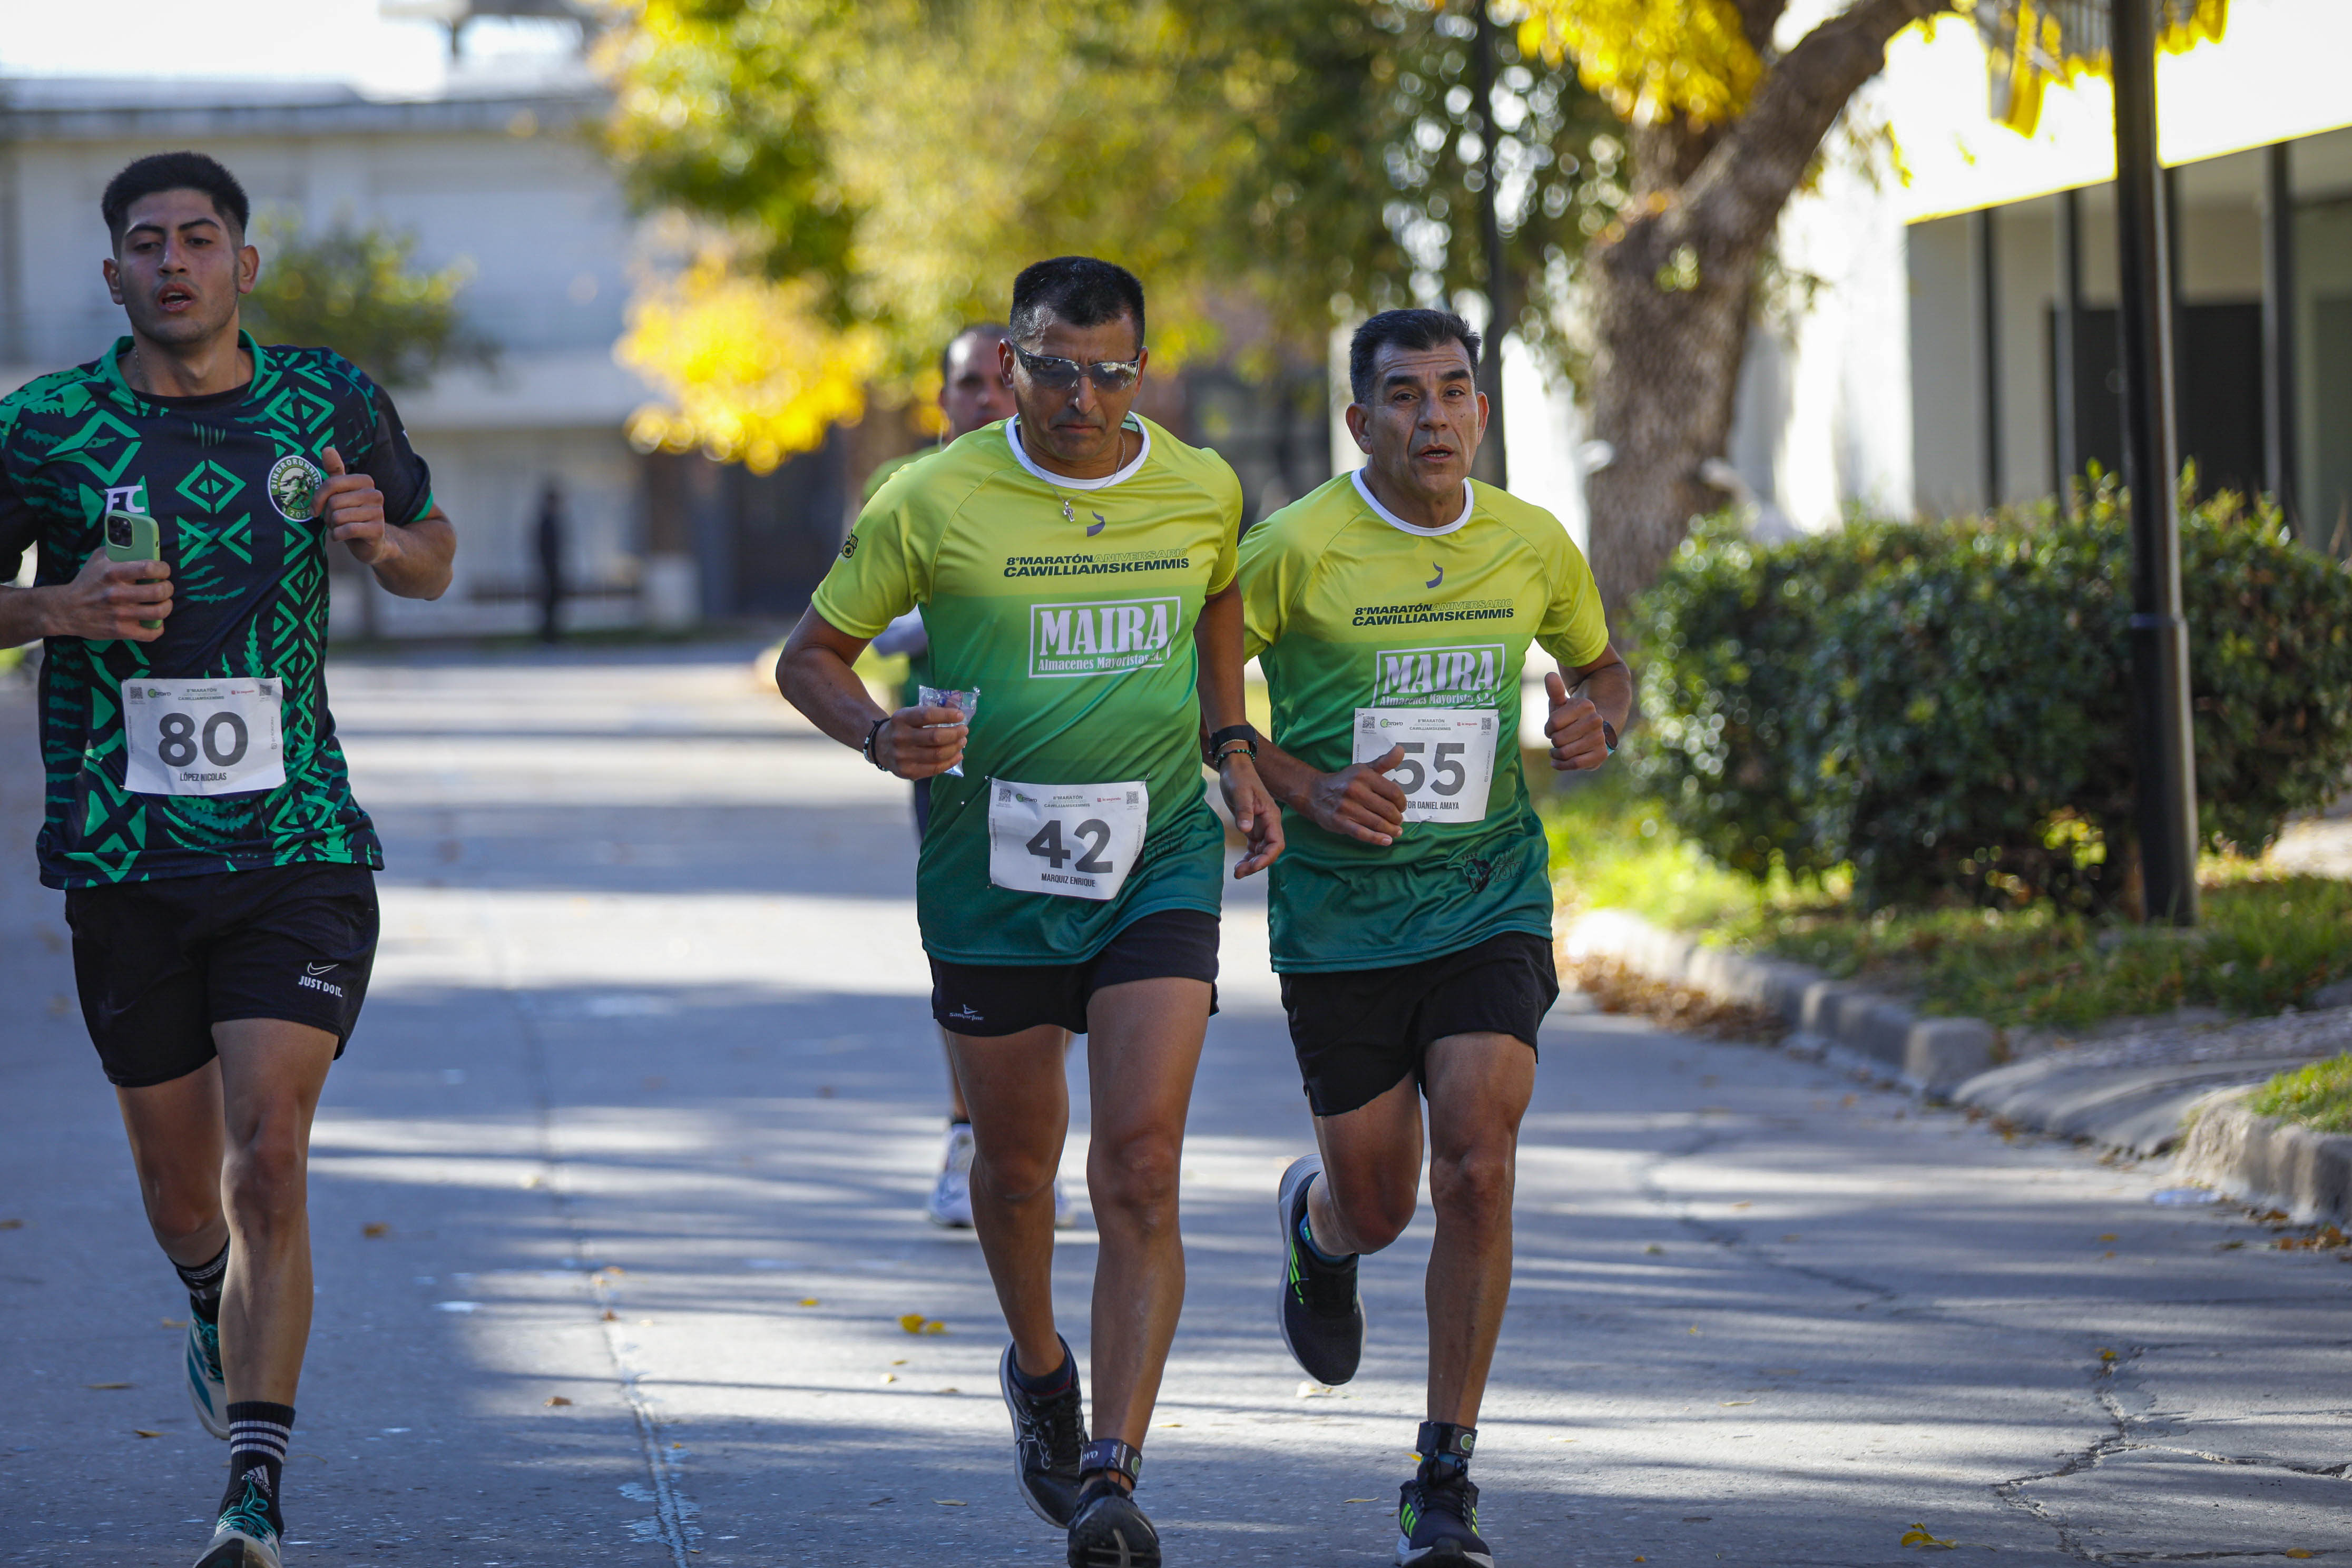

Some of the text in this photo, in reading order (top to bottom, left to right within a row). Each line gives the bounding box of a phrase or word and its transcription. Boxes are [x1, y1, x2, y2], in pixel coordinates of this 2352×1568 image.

[1003, 557, 1190, 577] CAWILLIAMSKEMMIS
[1352, 608, 1514, 626] CAWILLIAMSKEMMIS
[1040, 604, 1168, 656] MAIRA
[1038, 658, 1094, 671] Almacenes
[1097, 654, 1149, 669] Mayoristas
[1384, 651, 1493, 694] MAIRA
[1379, 695, 1427, 706] Almacenes
[1429, 693, 1474, 705] Mayoristas
[159, 711, 249, 767] 80
[180, 771, 227, 781] LÓPEZ NICOLAS
[1391, 742, 1466, 796] 55
[1417, 801, 1438, 809] DANIEL
[1439, 801, 1459, 810] AMAYA
[1025, 818, 1113, 874] 42
[1041, 873, 1096, 887] MARQUIZ ENRIQUE
[298, 975, 322, 990] JUST
[323, 982, 335, 994] DO
